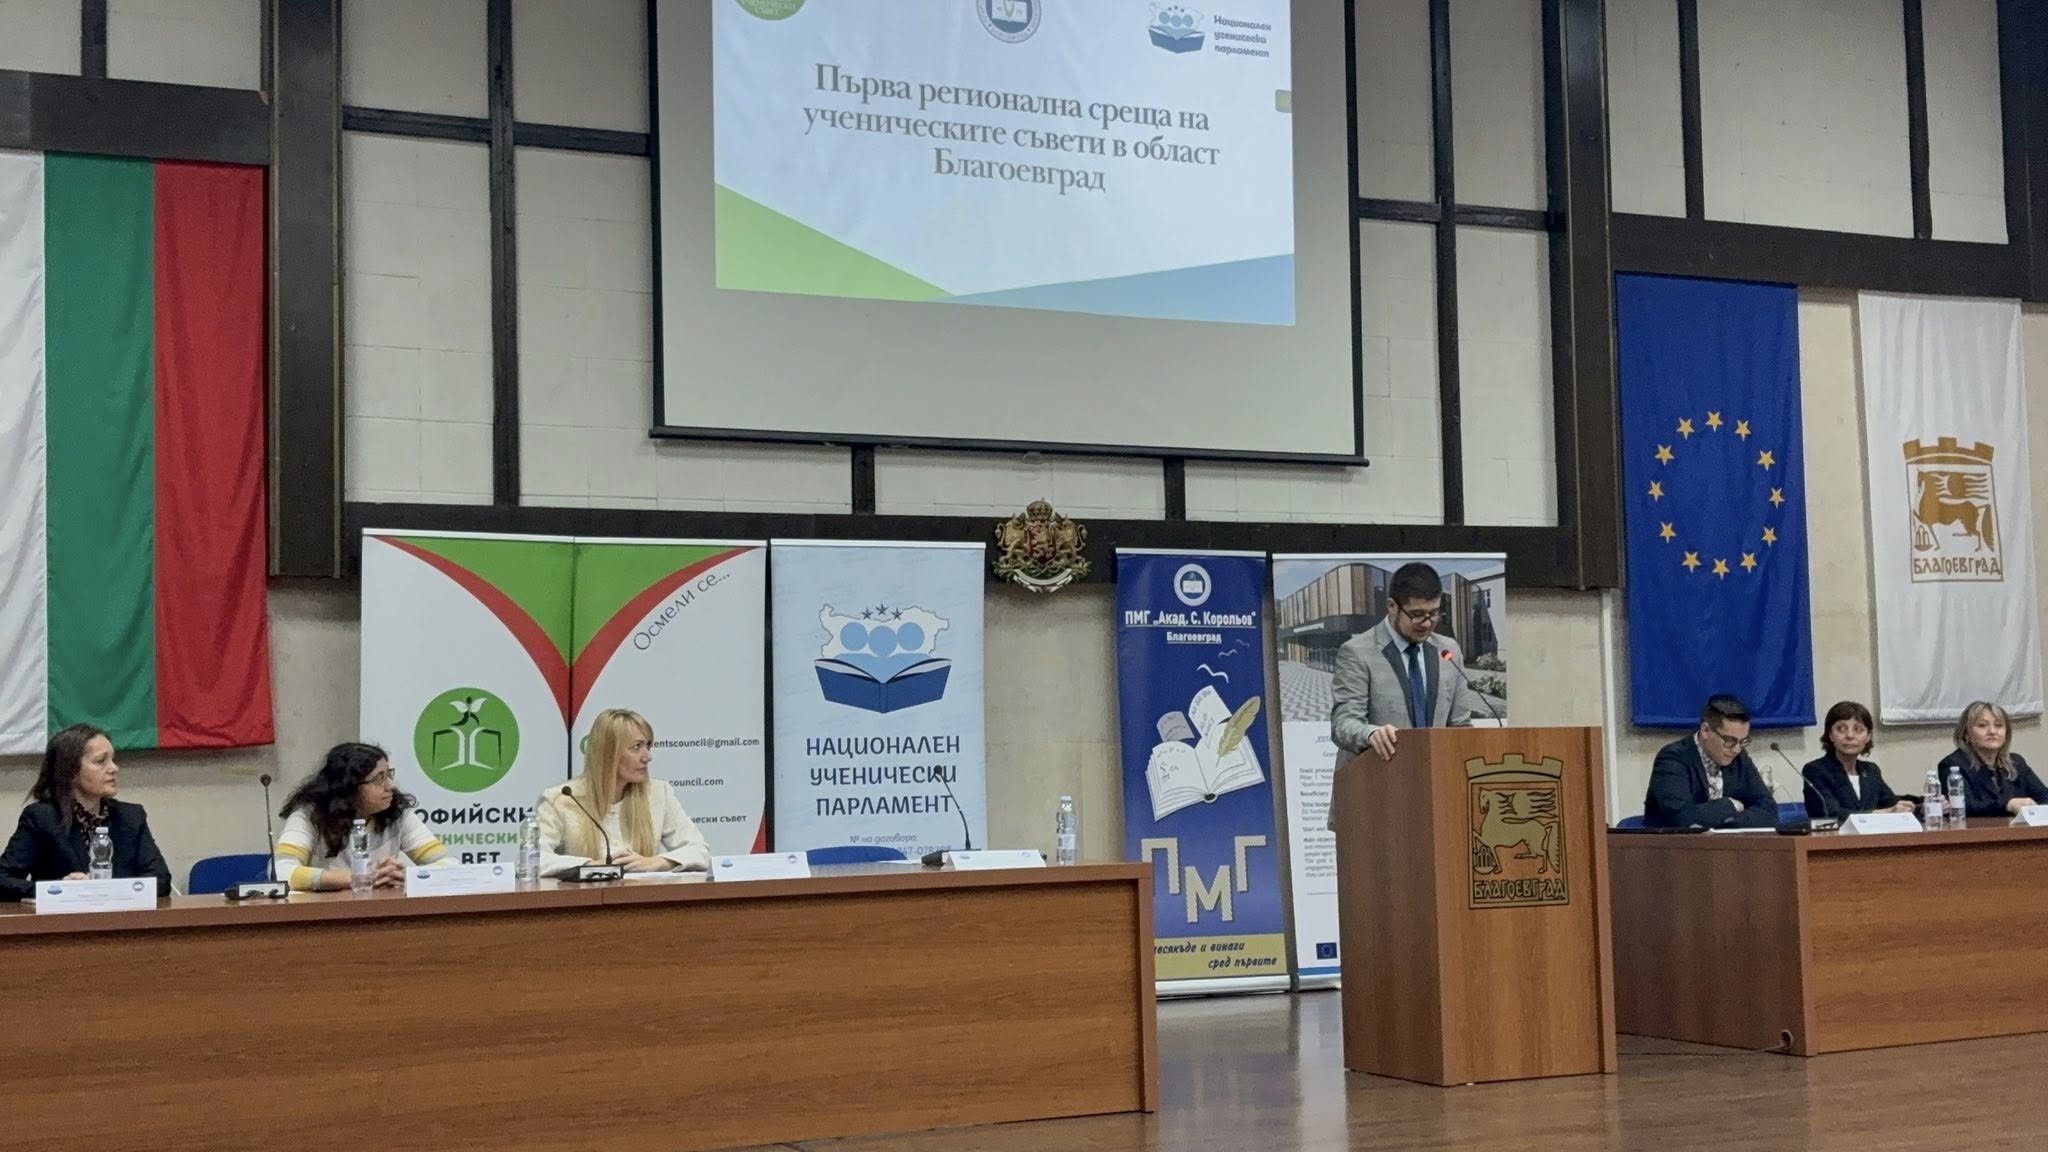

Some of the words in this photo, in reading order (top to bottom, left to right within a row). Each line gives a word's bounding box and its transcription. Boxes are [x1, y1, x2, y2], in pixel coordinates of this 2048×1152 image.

[815, 63, 912, 105] Първа
[919, 82, 1083, 119] регионална
[1088, 101, 1172, 130] среща
[1179, 110, 1210, 131] на
[802, 106, 1007, 145] ученическите
[1013, 127, 1105, 155] съвети
[1112, 138, 1127, 157] в
[1133, 135, 1220, 165] област
[933, 147, 1106, 195] Благоевград
[1913, 557, 2002, 576] БЛАГОЕВГРАД
[633, 589, 696, 650] Осмели
[1125, 611, 1151, 625] ПМГ
[1190, 611, 1201, 625] С.
[1166, 631, 1222, 644] Благоевград
[653, 737, 760, 749] entscouncil@gmail.com
[806, 735, 960, 759] НАЦИОНАЛЕН
[668, 777, 724, 787] council.com
[810, 765, 957, 786] УЧЕНИЧЕСКИ
[414, 803, 533, 824] ОФИЙСКИ
[816, 795, 953, 816] ПАРЛАМЕНТ
[434, 833, 518, 845] НИЧЕСКИ
[462, 851, 501, 865] ВЕТ
[1141, 835, 1267, 923] ПМГ
[1473, 878, 1566, 900] БЛАГОЕВГРАД
[1153, 941, 1197, 954] всякъде
[1200, 944, 1207, 952] и
[1210, 942, 1246, 952] винаги
[1208, 956, 1232, 970] сред
[1234, 957, 1278, 969] първите
